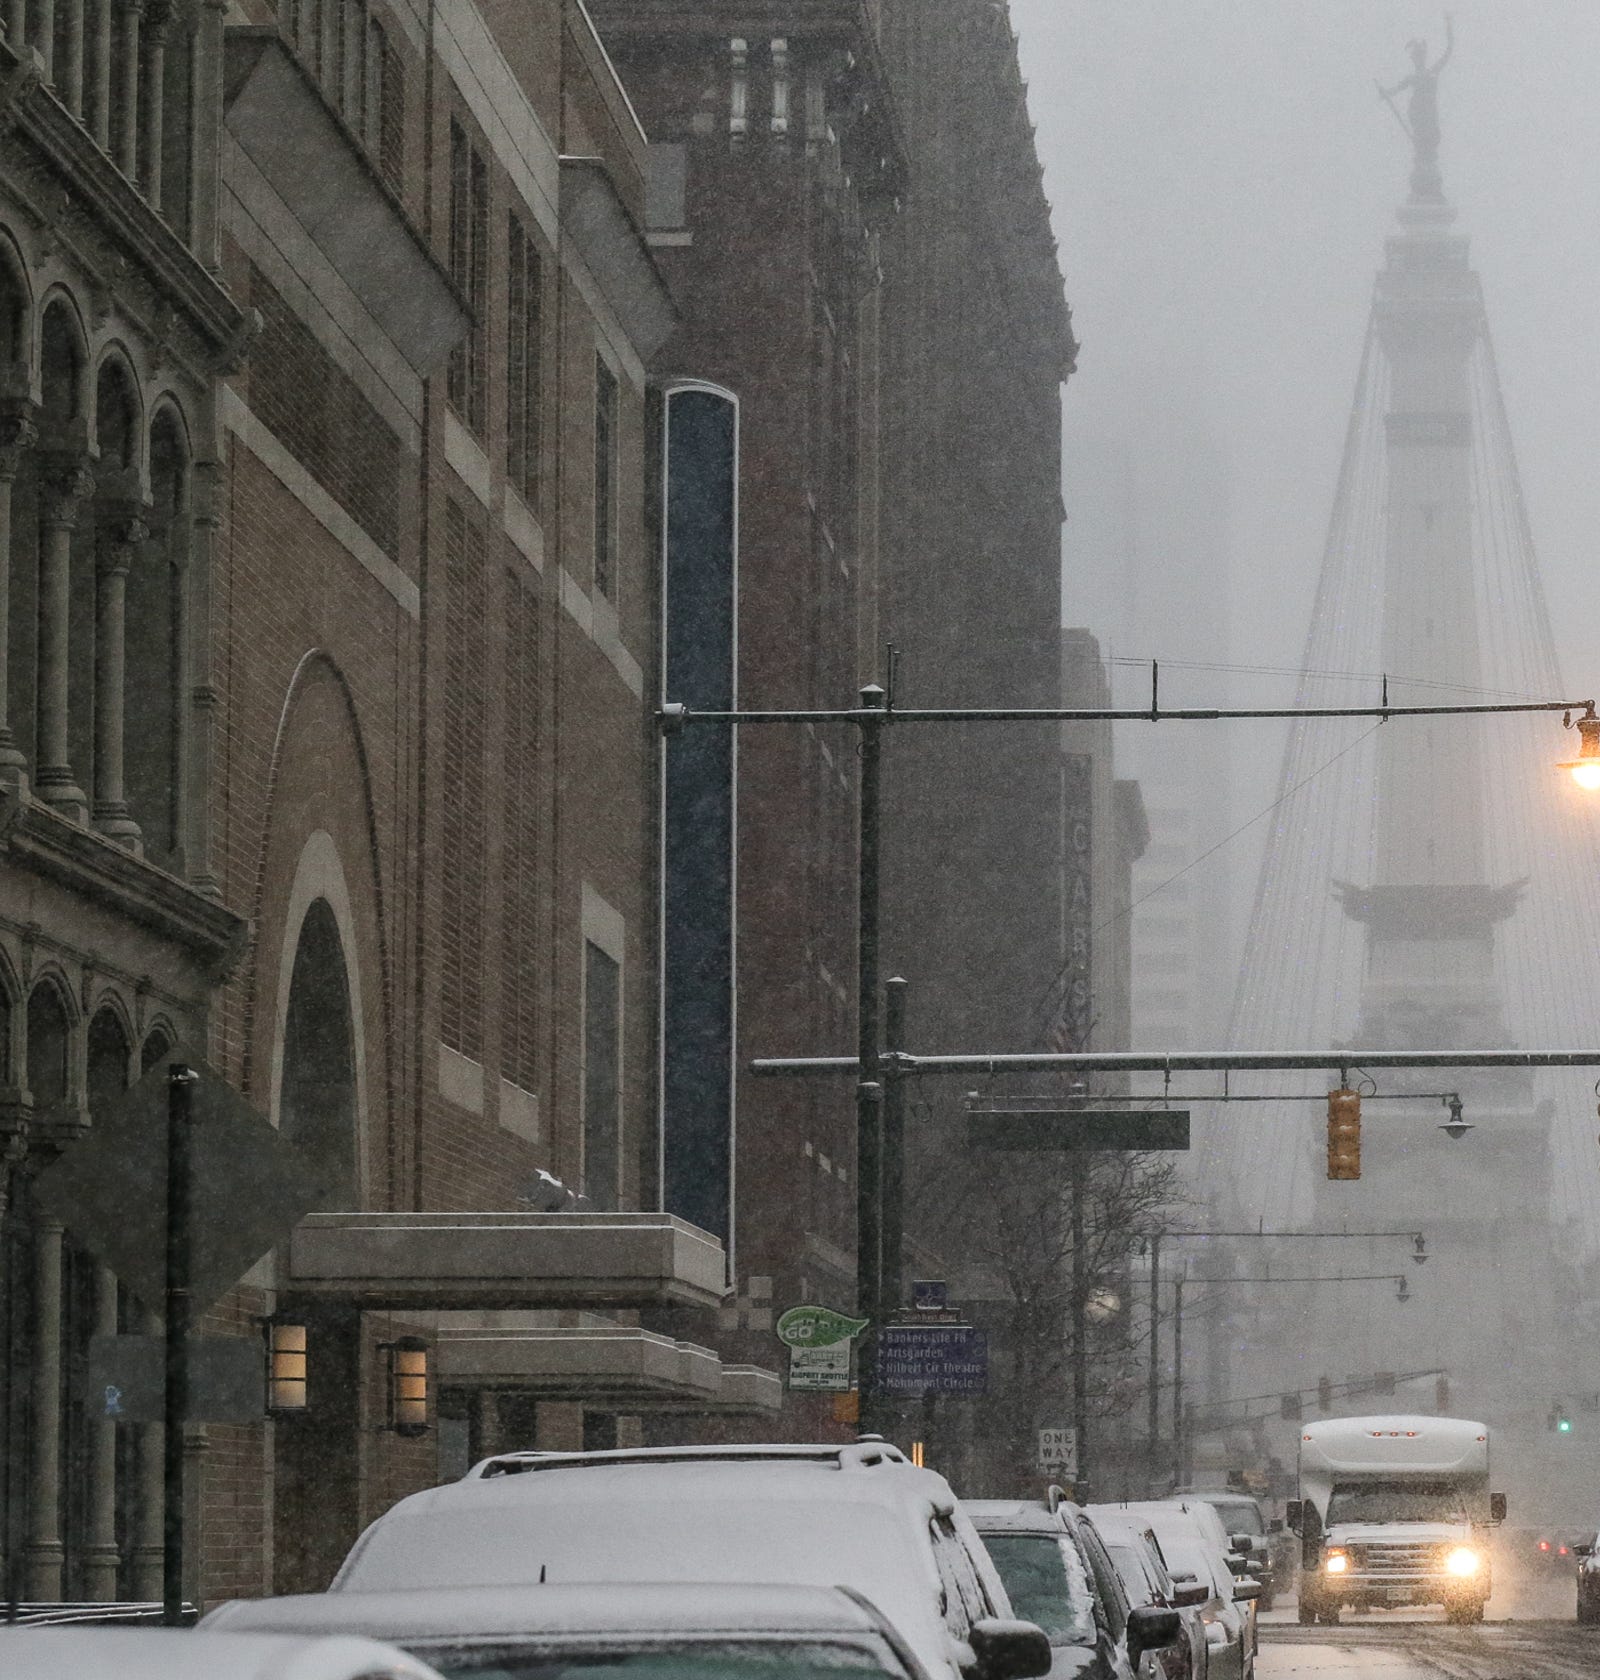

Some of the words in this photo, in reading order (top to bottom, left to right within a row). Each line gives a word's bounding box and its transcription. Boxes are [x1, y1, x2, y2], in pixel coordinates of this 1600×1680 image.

[887, 1332, 928, 1343] Bankers
[931, 1332, 951, 1343] Life
[887, 1348, 944, 1361] Artsgarden
[886, 1362, 921, 1374] Hilbert
[925, 1362, 940, 1373] Cir
[943, 1362, 981, 1374] Theatre
[886, 1378, 940, 1389] Monument
[943, 1378, 974, 1388] Circle
[1043, 1432, 1073, 1444] ONE
[1042, 1447, 1074, 1458] WAY
